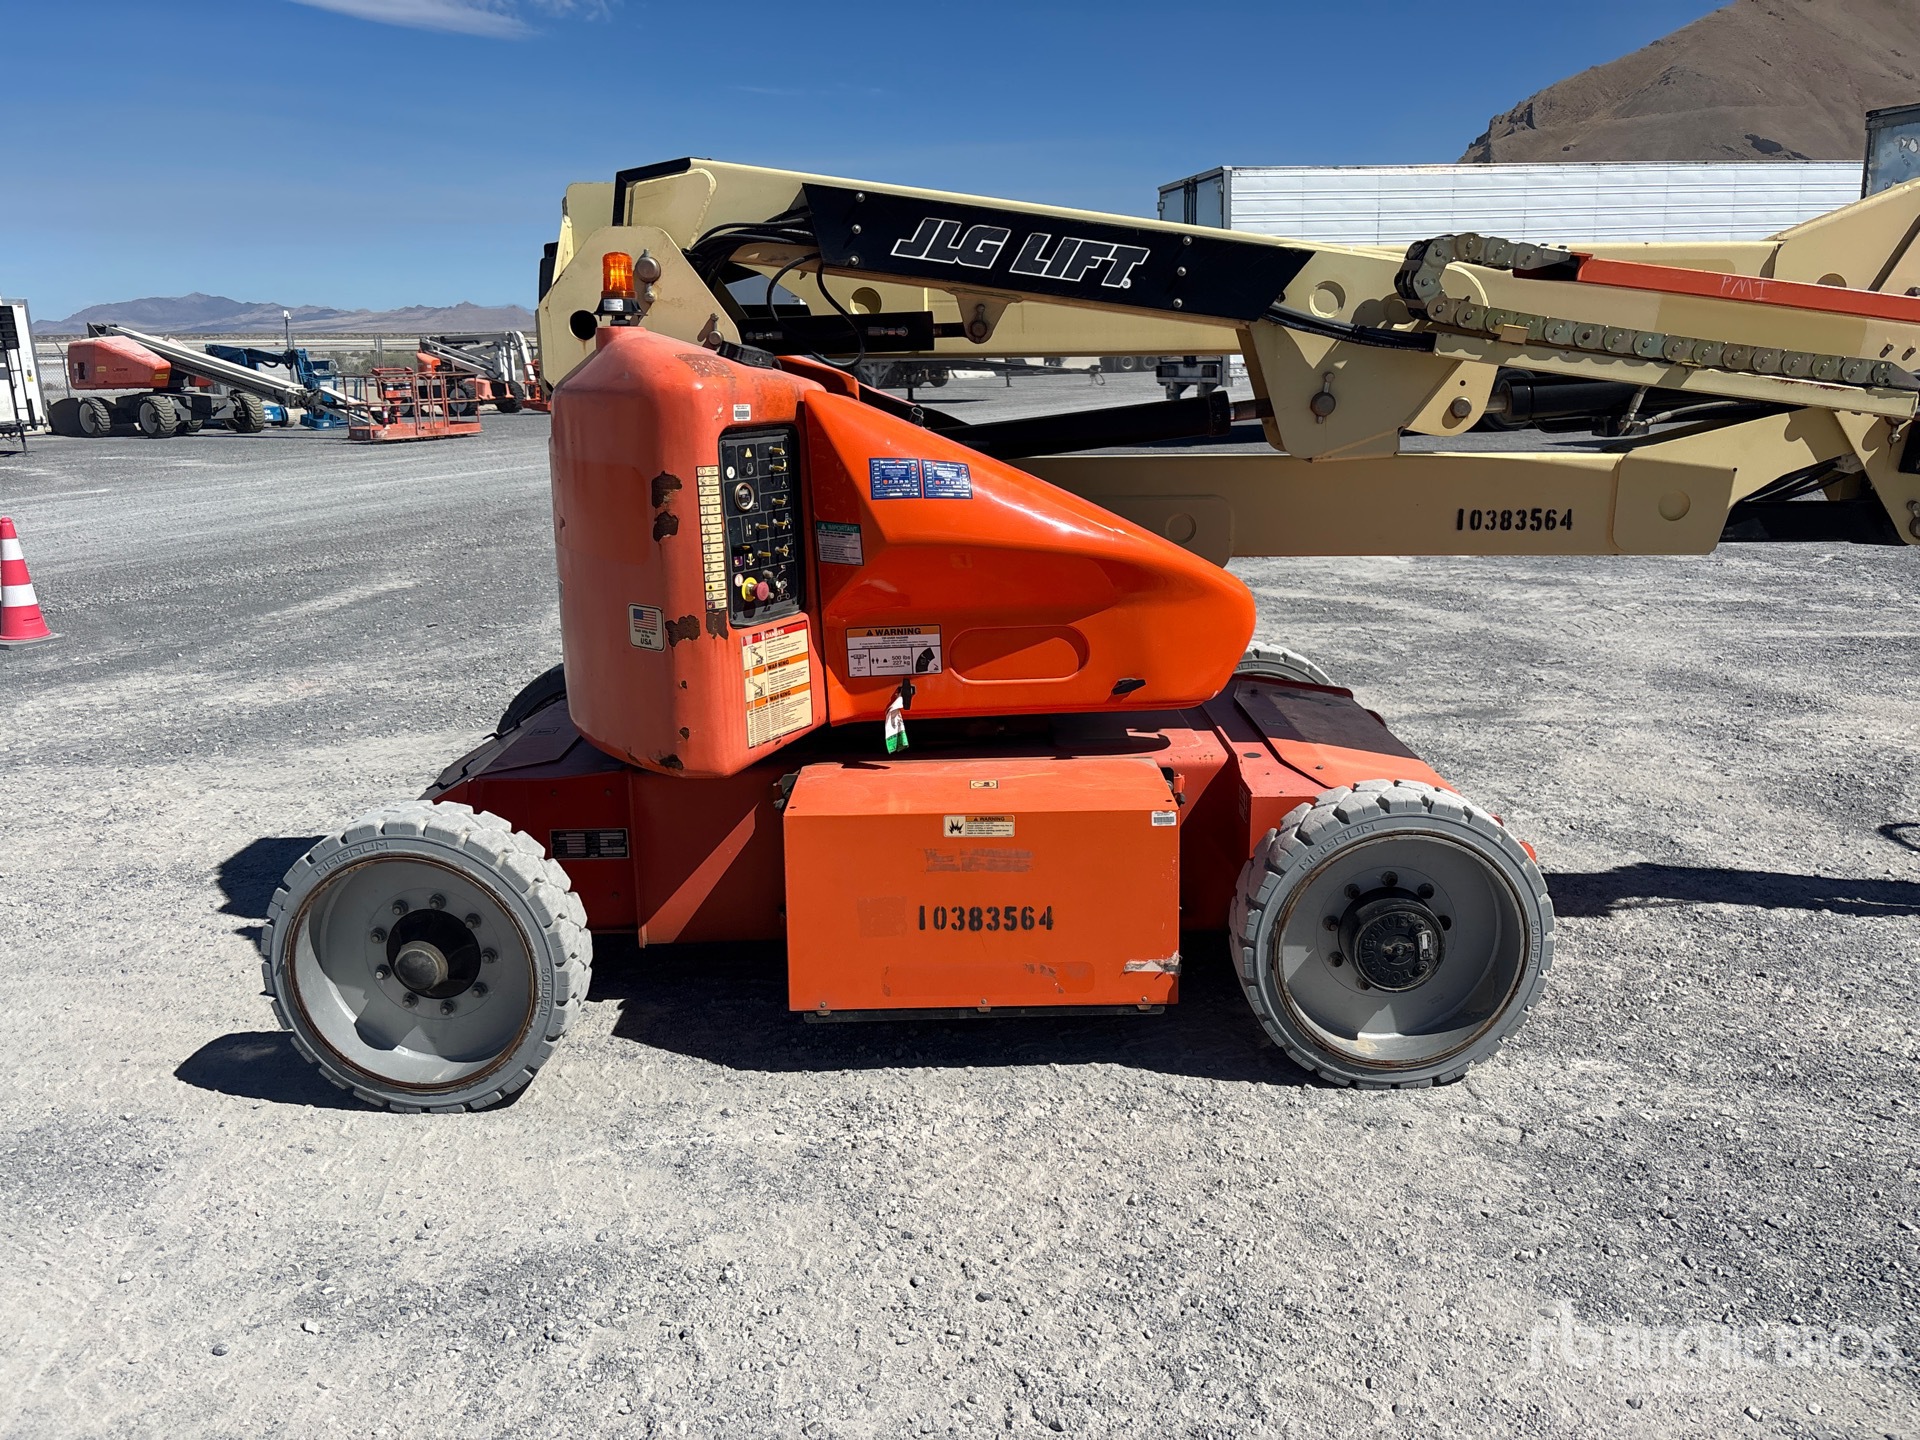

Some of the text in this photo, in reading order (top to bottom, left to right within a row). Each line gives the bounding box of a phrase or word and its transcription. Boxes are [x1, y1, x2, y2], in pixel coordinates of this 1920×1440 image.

[890, 217, 1012, 270] JLG
[1720, 276, 1776, 301] PMI
[828, 524, 858, 532] IMPORTANT
[1456, 508, 1573, 531] 10383564
[640, 637, 652, 646] USA
[875, 627, 922, 636] WARNING
[918, 905, 1054, 932] 10383564
[1527, 920, 1540, 971] SOLIDEAL
[538, 967, 551, 1018] SOLIDEAL
